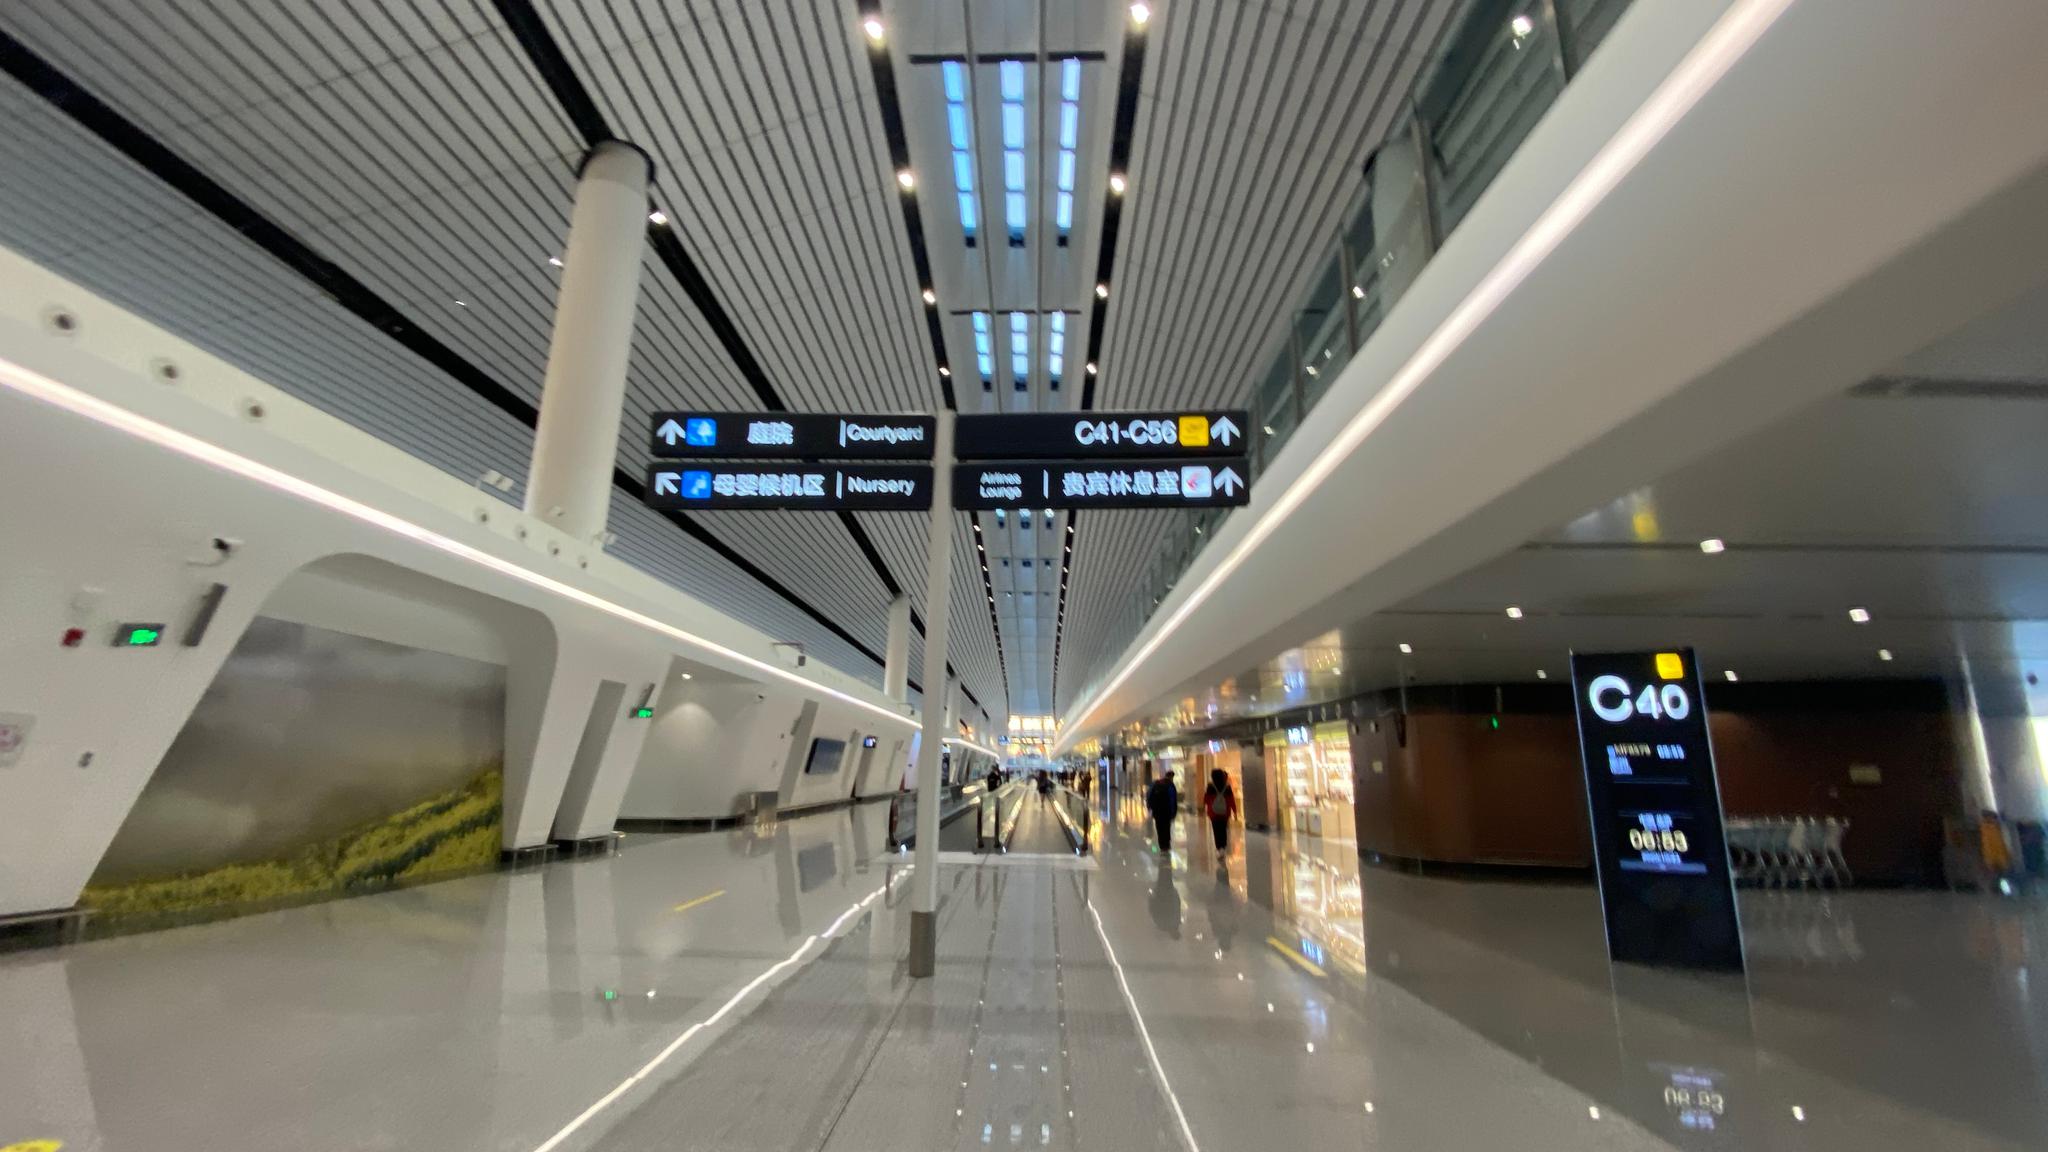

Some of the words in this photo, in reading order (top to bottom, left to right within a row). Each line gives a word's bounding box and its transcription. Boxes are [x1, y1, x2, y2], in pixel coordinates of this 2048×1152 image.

[847, 423, 924, 444] Courtyard
[1075, 419, 1178, 446] C41-C56
[848, 476, 915, 497] Nursery
[980, 485, 1023, 500] Lounge
[1062, 470, 1181, 496] 贵宾休息室
[1589, 674, 1690, 723] C40
